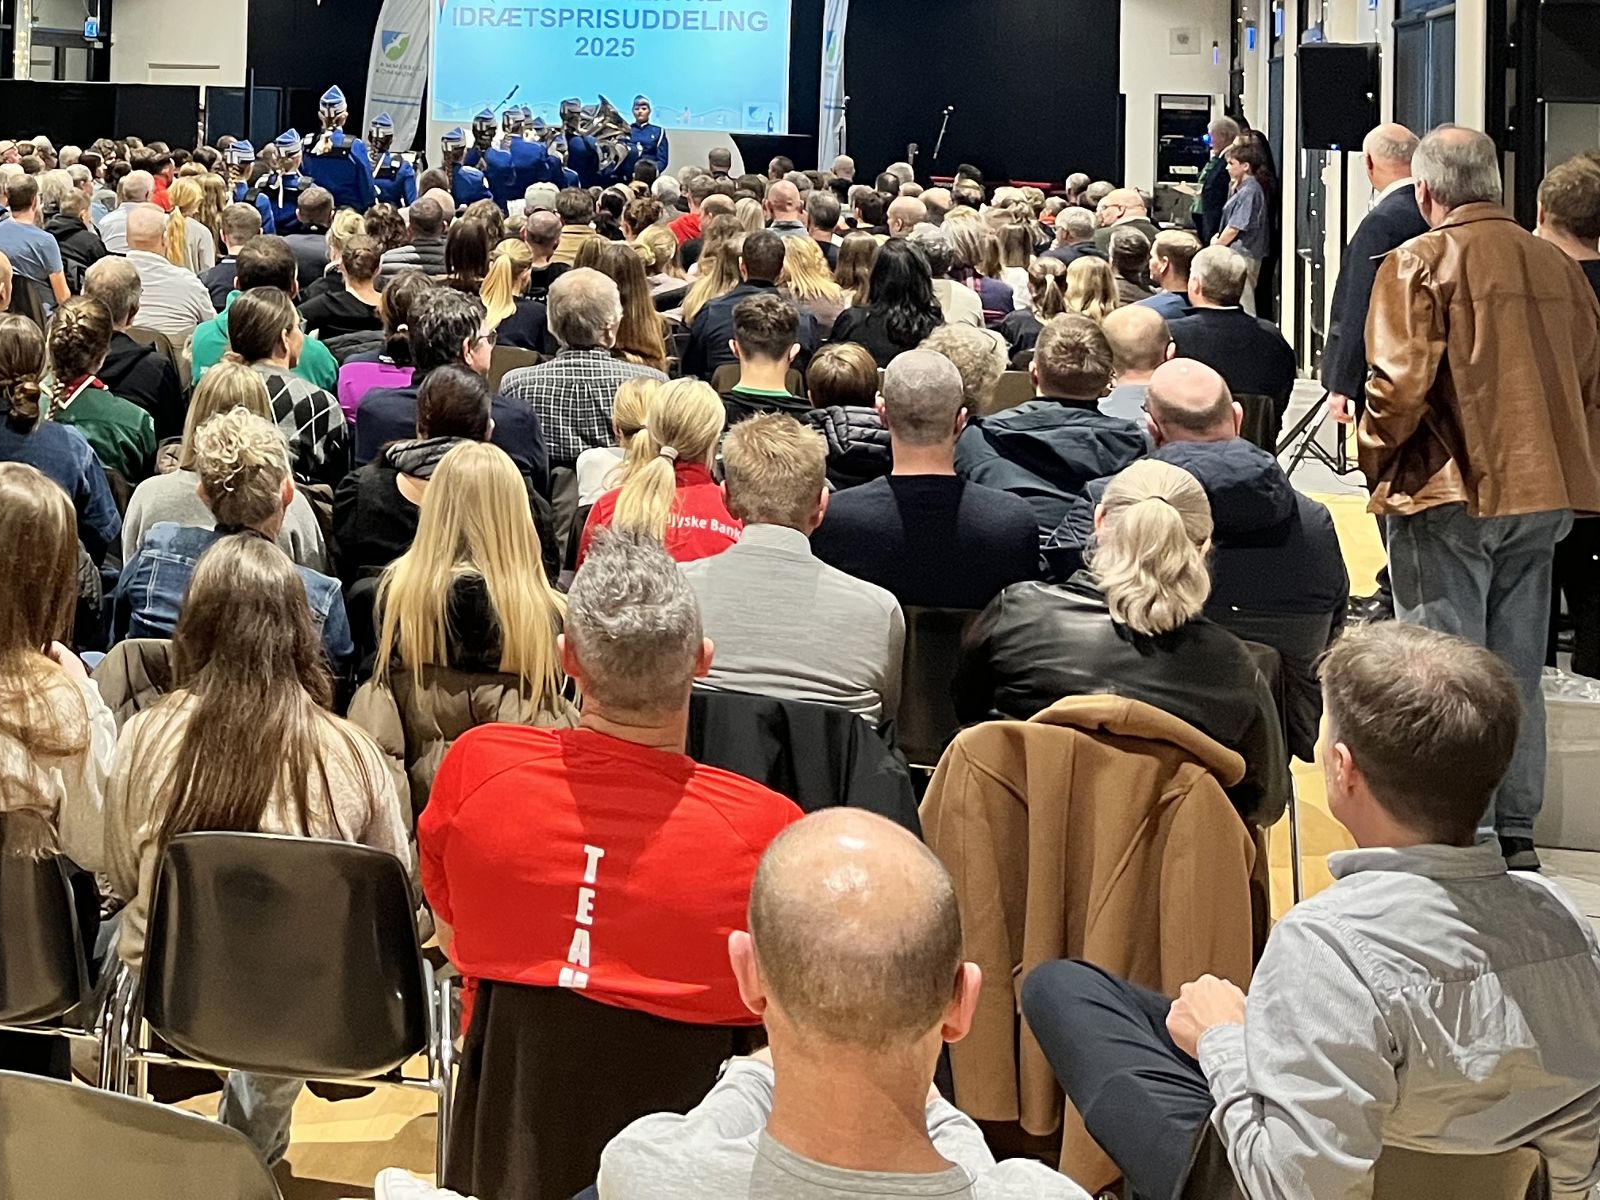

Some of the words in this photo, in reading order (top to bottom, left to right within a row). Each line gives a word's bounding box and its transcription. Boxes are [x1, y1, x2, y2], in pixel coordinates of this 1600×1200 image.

[452, 7, 769, 32] IDRÆTSPRISUDDELING
[574, 37, 635, 58] 2025
[710, 518, 742, 539] Bank
